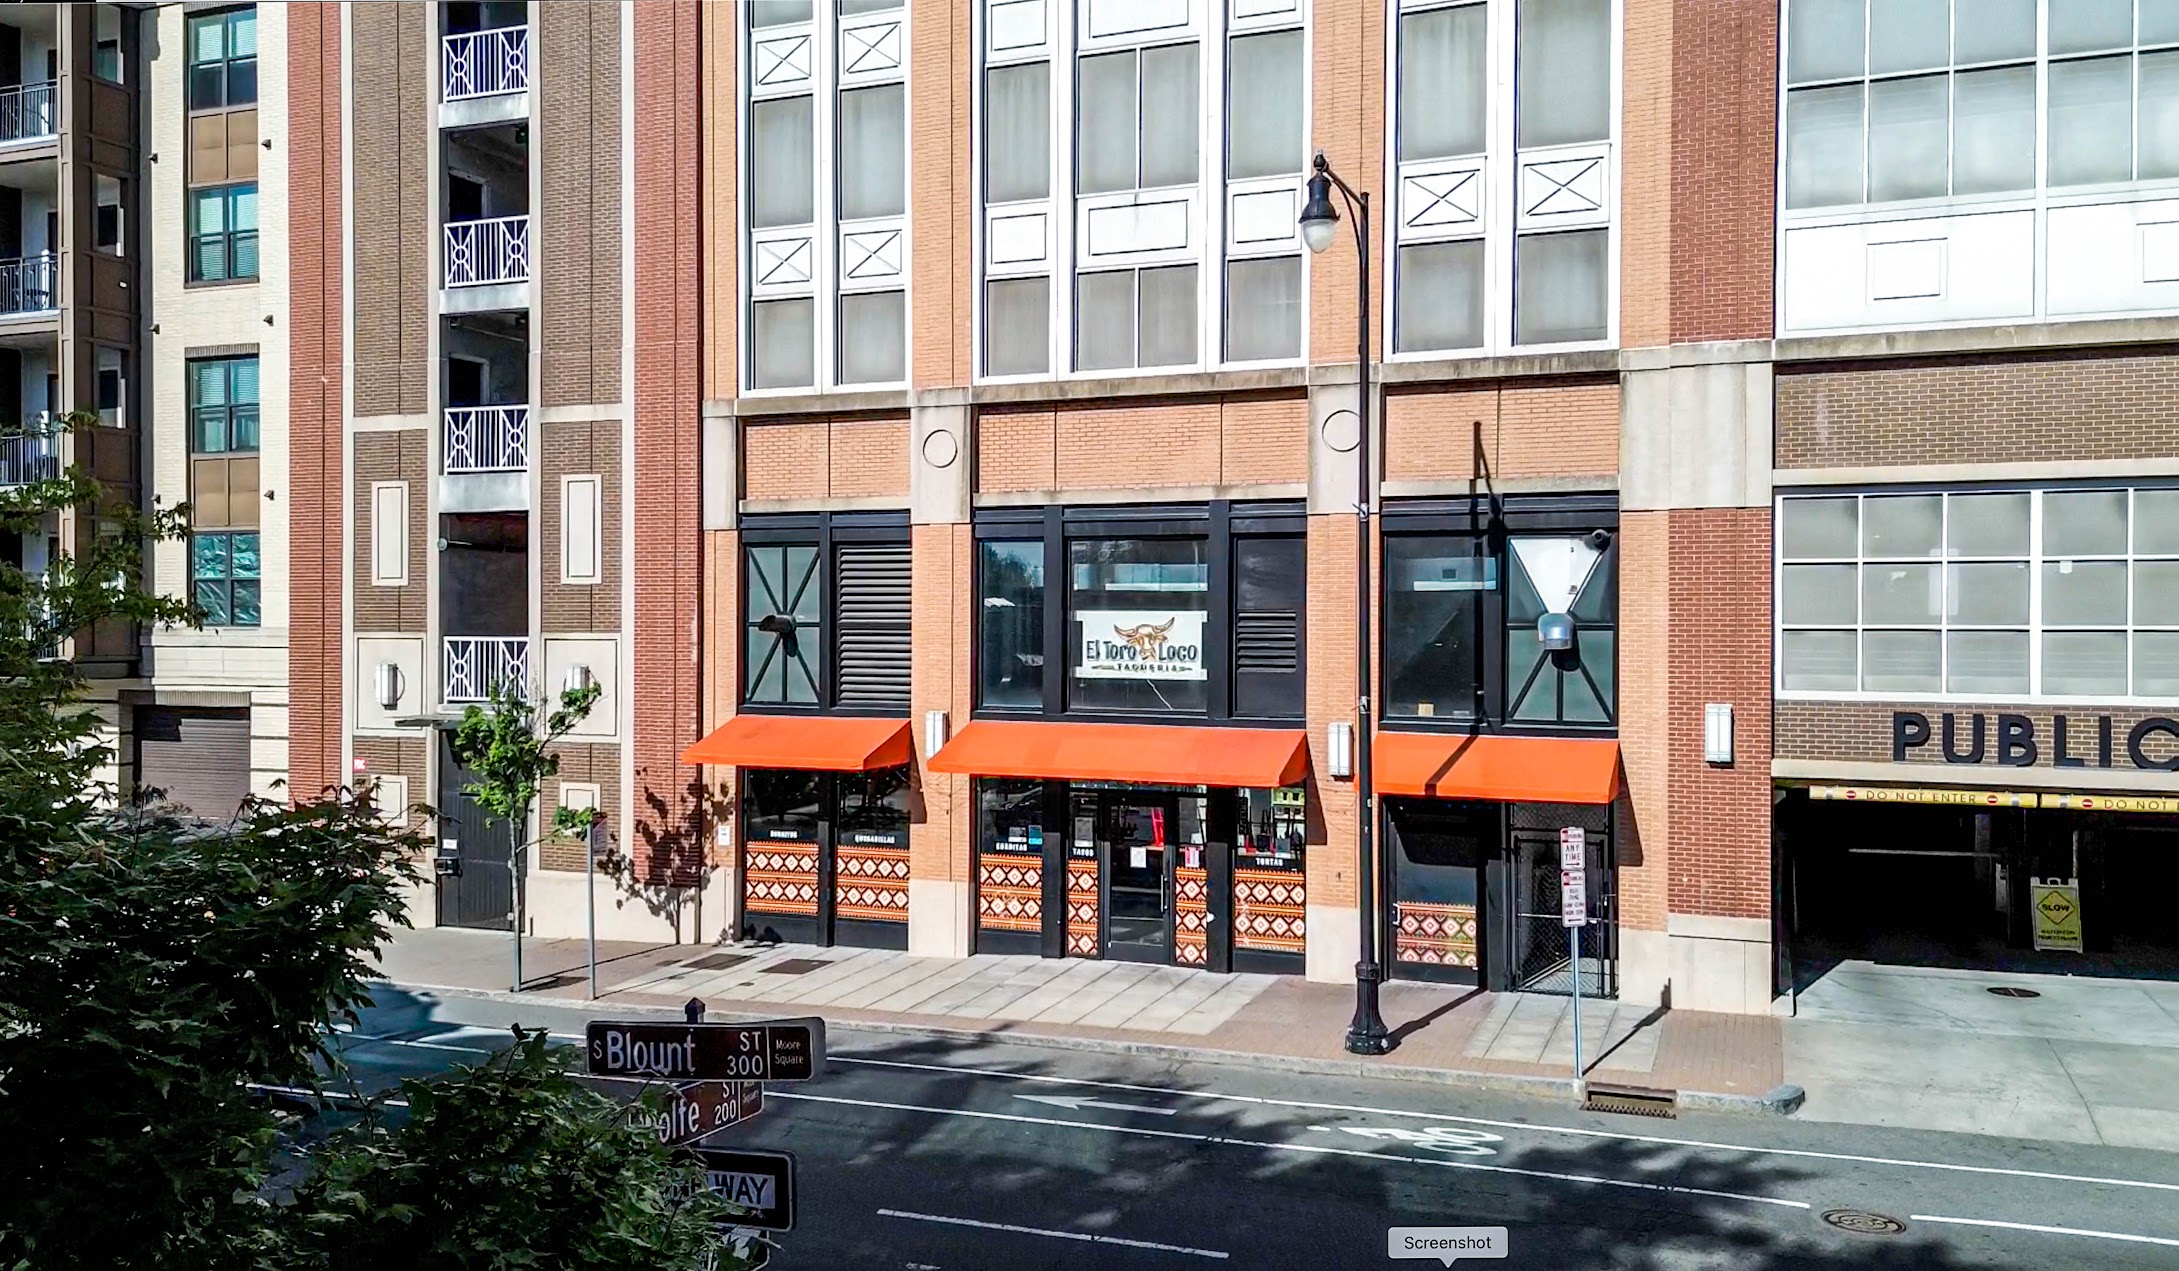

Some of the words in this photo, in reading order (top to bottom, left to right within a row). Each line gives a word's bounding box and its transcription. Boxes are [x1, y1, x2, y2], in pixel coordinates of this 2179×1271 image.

[1086, 639, 1100, 661] El
[1102, 640, 1137, 661] Toro
[1117, 663, 1177, 673] TAQUERIA
[1893, 711, 2179, 772] PUBLIC
[1866, 790, 1888, 800] DO
[1896, 791, 1925, 801] NOT
[1933, 793, 1977, 804] ENTER
[2104, 799, 2127, 810] DO
[2136, 800, 2167, 811] NOT
[1072, 847, 1095, 857] TACOS
[1566, 844, 1580, 852] ANY
[1256, 857, 1284, 867] TORTAS
[1565, 852, 1581, 861] TIME
[2042, 904, 2070, 912] SLOW
[775, 1039, 801, 1051] Moore
[593, 1039, 603, 1060] S
[606, 1030, 697, 1074] Blount
[739, 1031, 762, 1052] ST
[726, 1054, 764, 1077] 300
[774, 1053, 804, 1066] Square
[714, 1099, 737, 1126] 200
[641, 1098, 700, 1144] olfe
[713, 1173, 769, 1205] WAY
